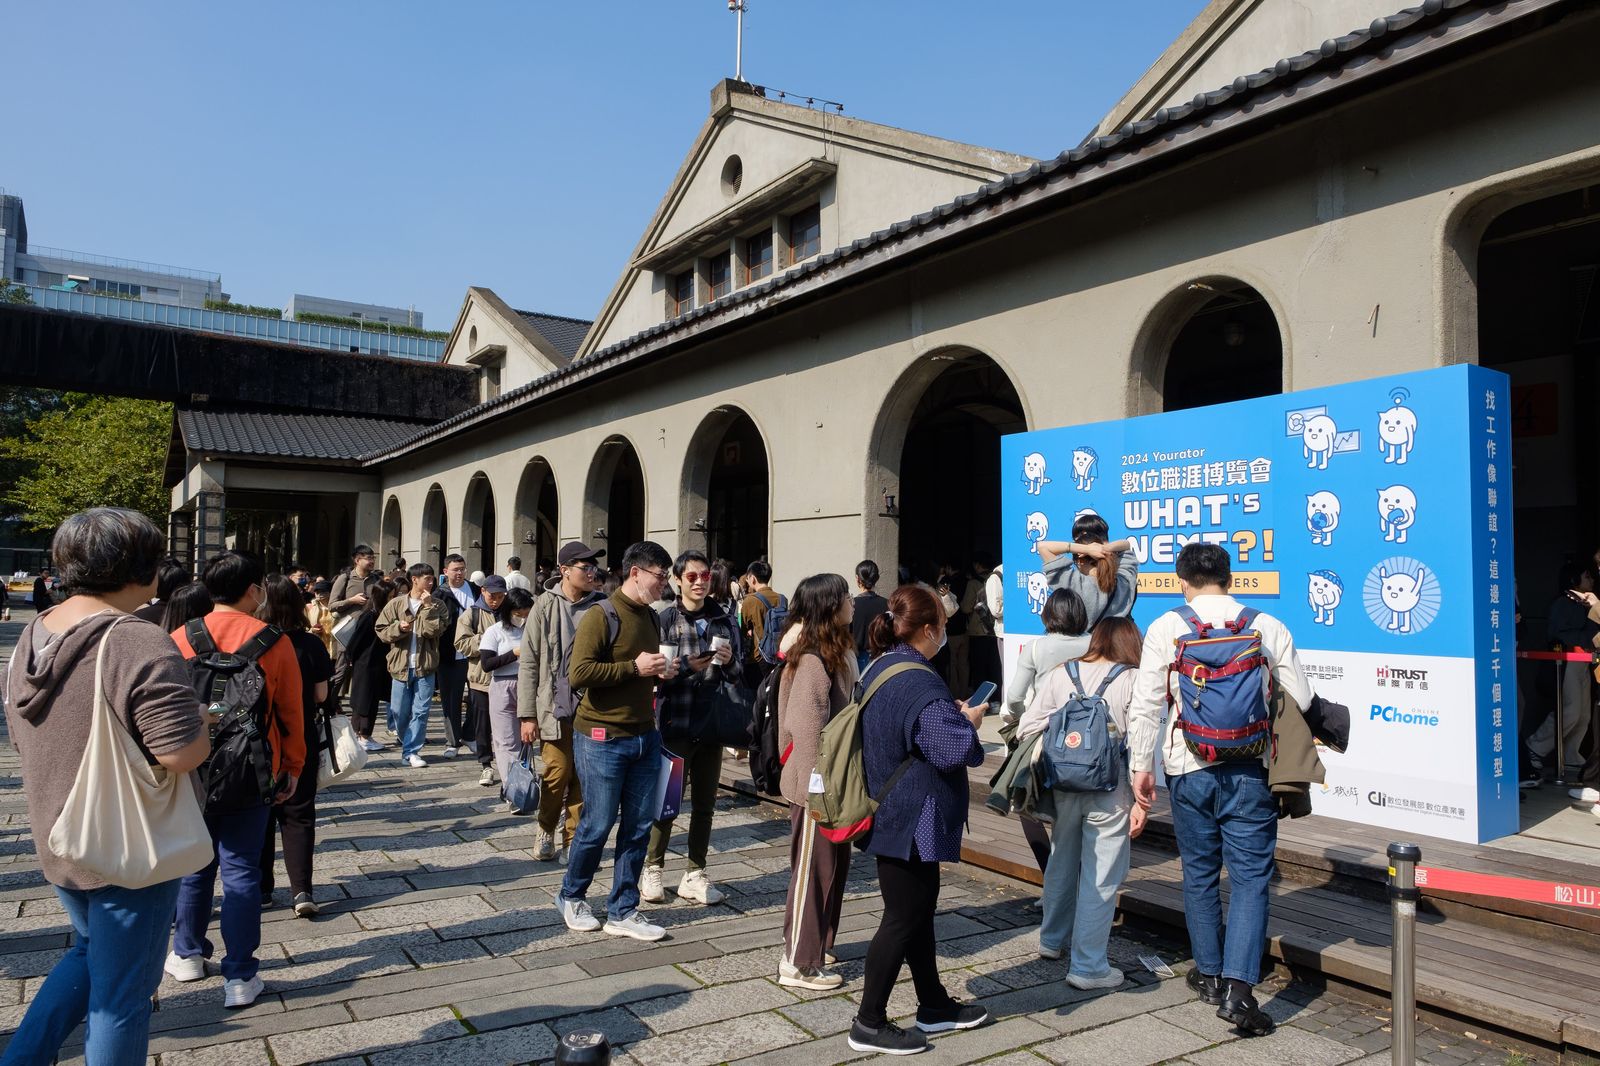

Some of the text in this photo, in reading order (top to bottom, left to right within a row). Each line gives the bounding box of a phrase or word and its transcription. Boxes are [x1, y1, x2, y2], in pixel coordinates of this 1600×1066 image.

[1121, 448, 1206, 466] 2024 Yourator
[1121, 457, 1272, 494] 數位職涯博覽會
[1123, 492, 1261, 530] WHAT's
[1234, 577, 1259, 588] ERS
[1303, 672, 1344, 681] ANSOFT
[1376, 665, 1428, 681] HiTRUST
[1369, 704, 1439, 727] PChome
[1555, 885, 1600, 906] 松山
